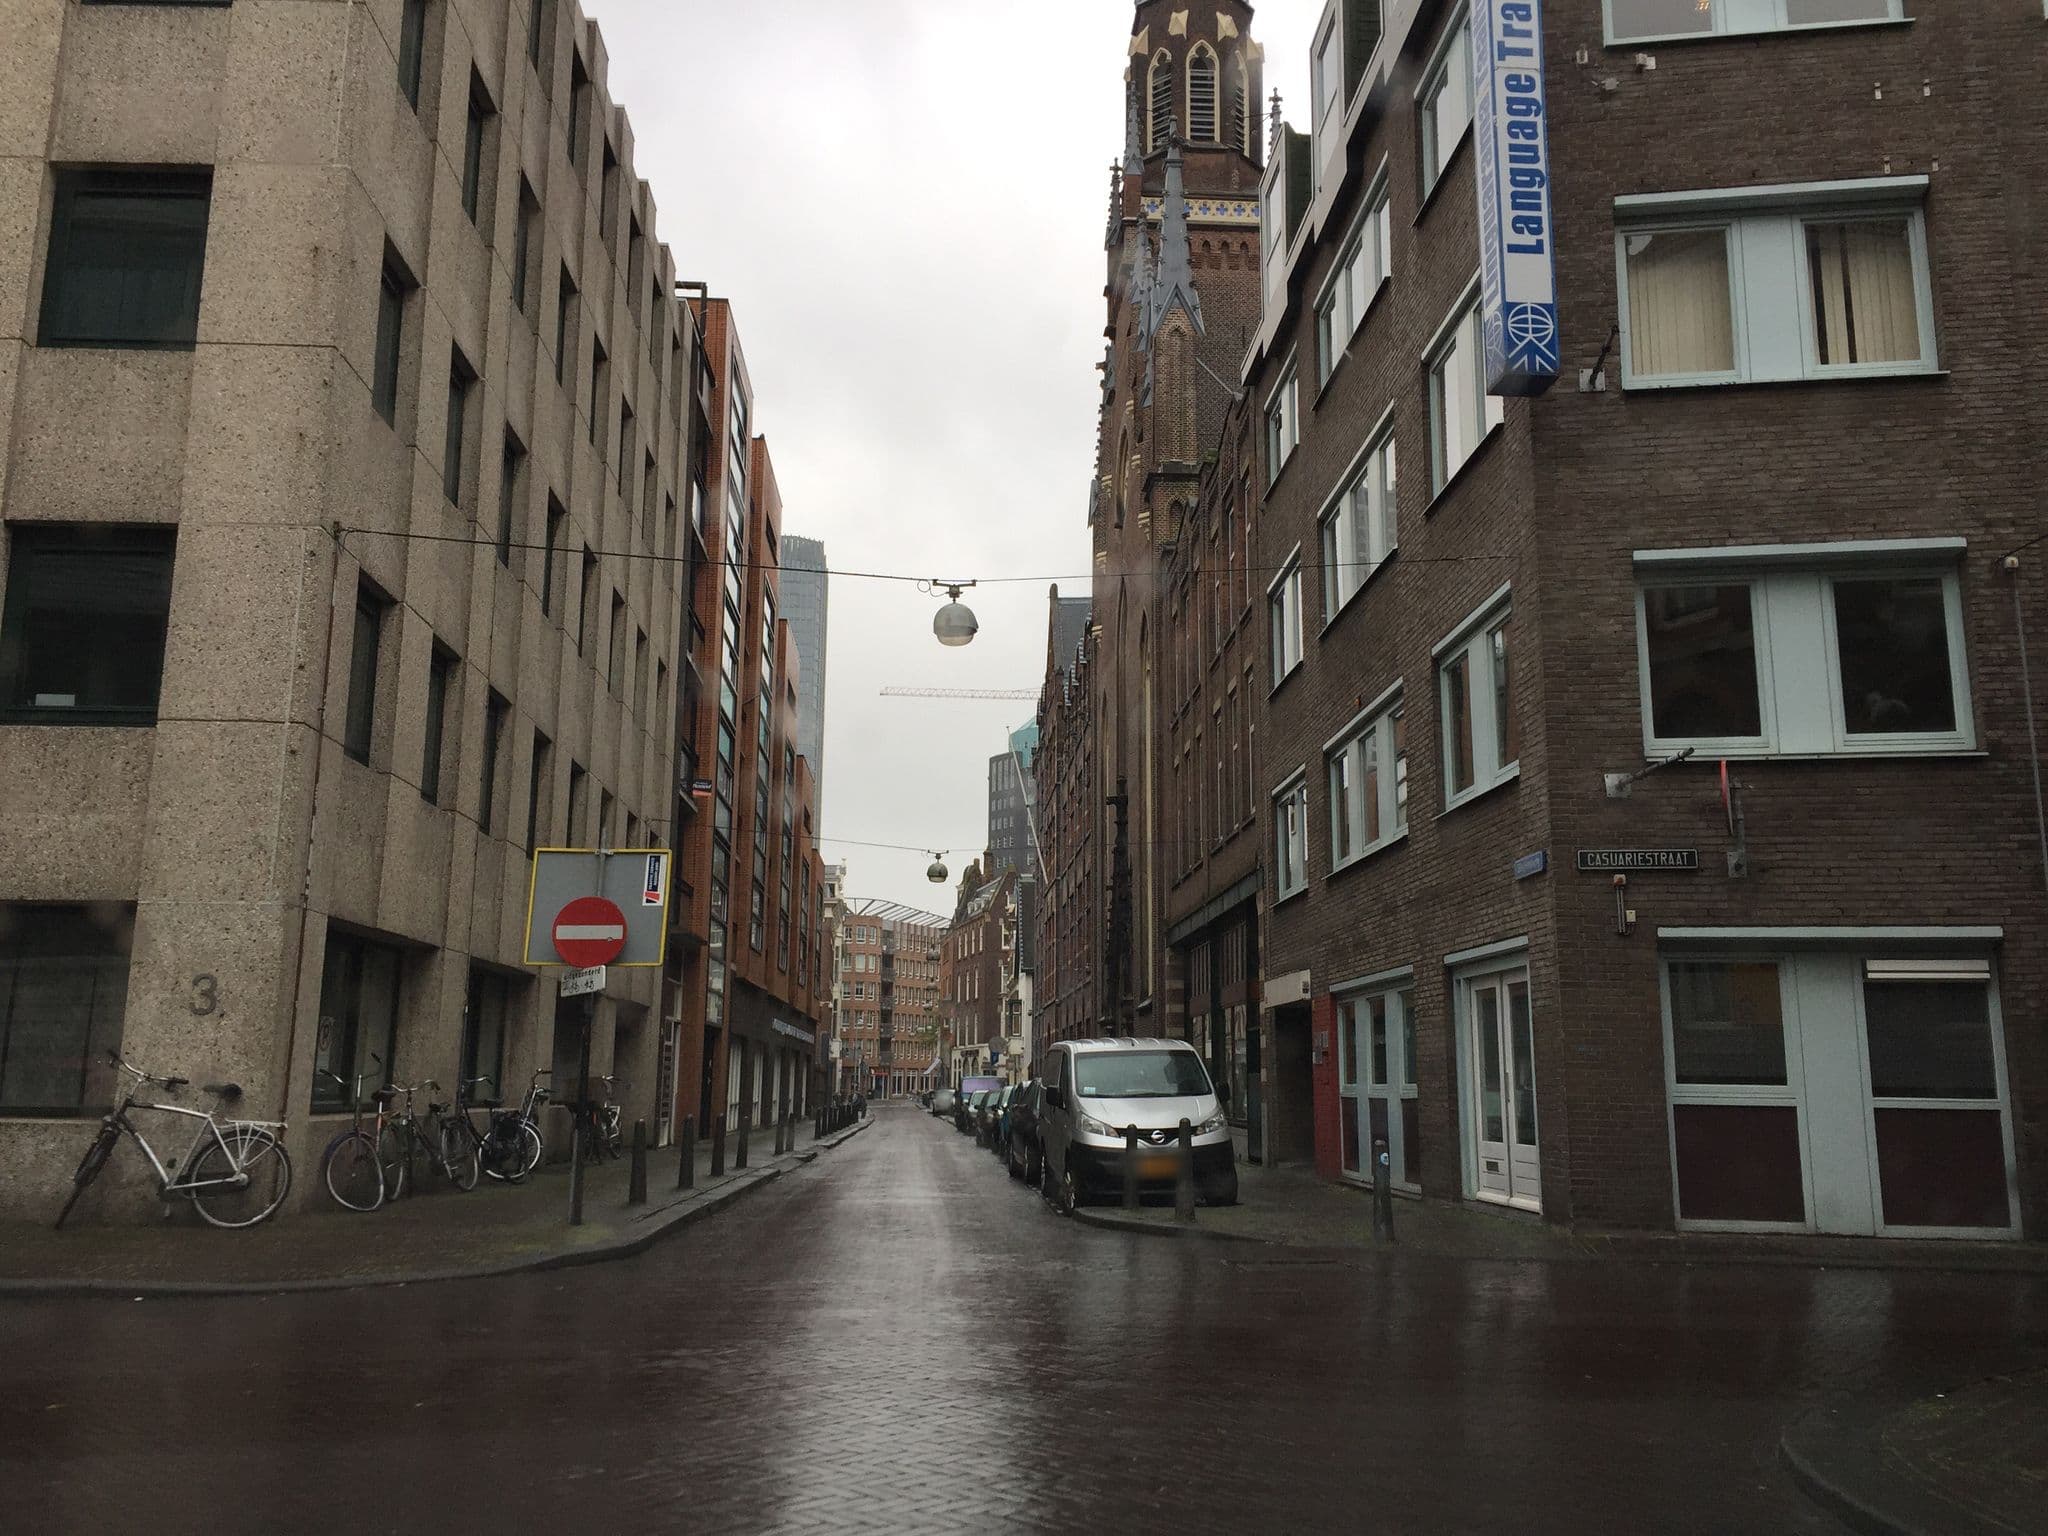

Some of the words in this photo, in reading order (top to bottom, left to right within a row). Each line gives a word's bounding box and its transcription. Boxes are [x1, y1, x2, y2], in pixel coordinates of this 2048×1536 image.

[1497, 3, 1534, 62] Tra
[1504, 73, 1545, 255] Language
[1587, 852, 1689, 866] CASUARIESTRAAT
[190, 973, 218, 1016] 3
